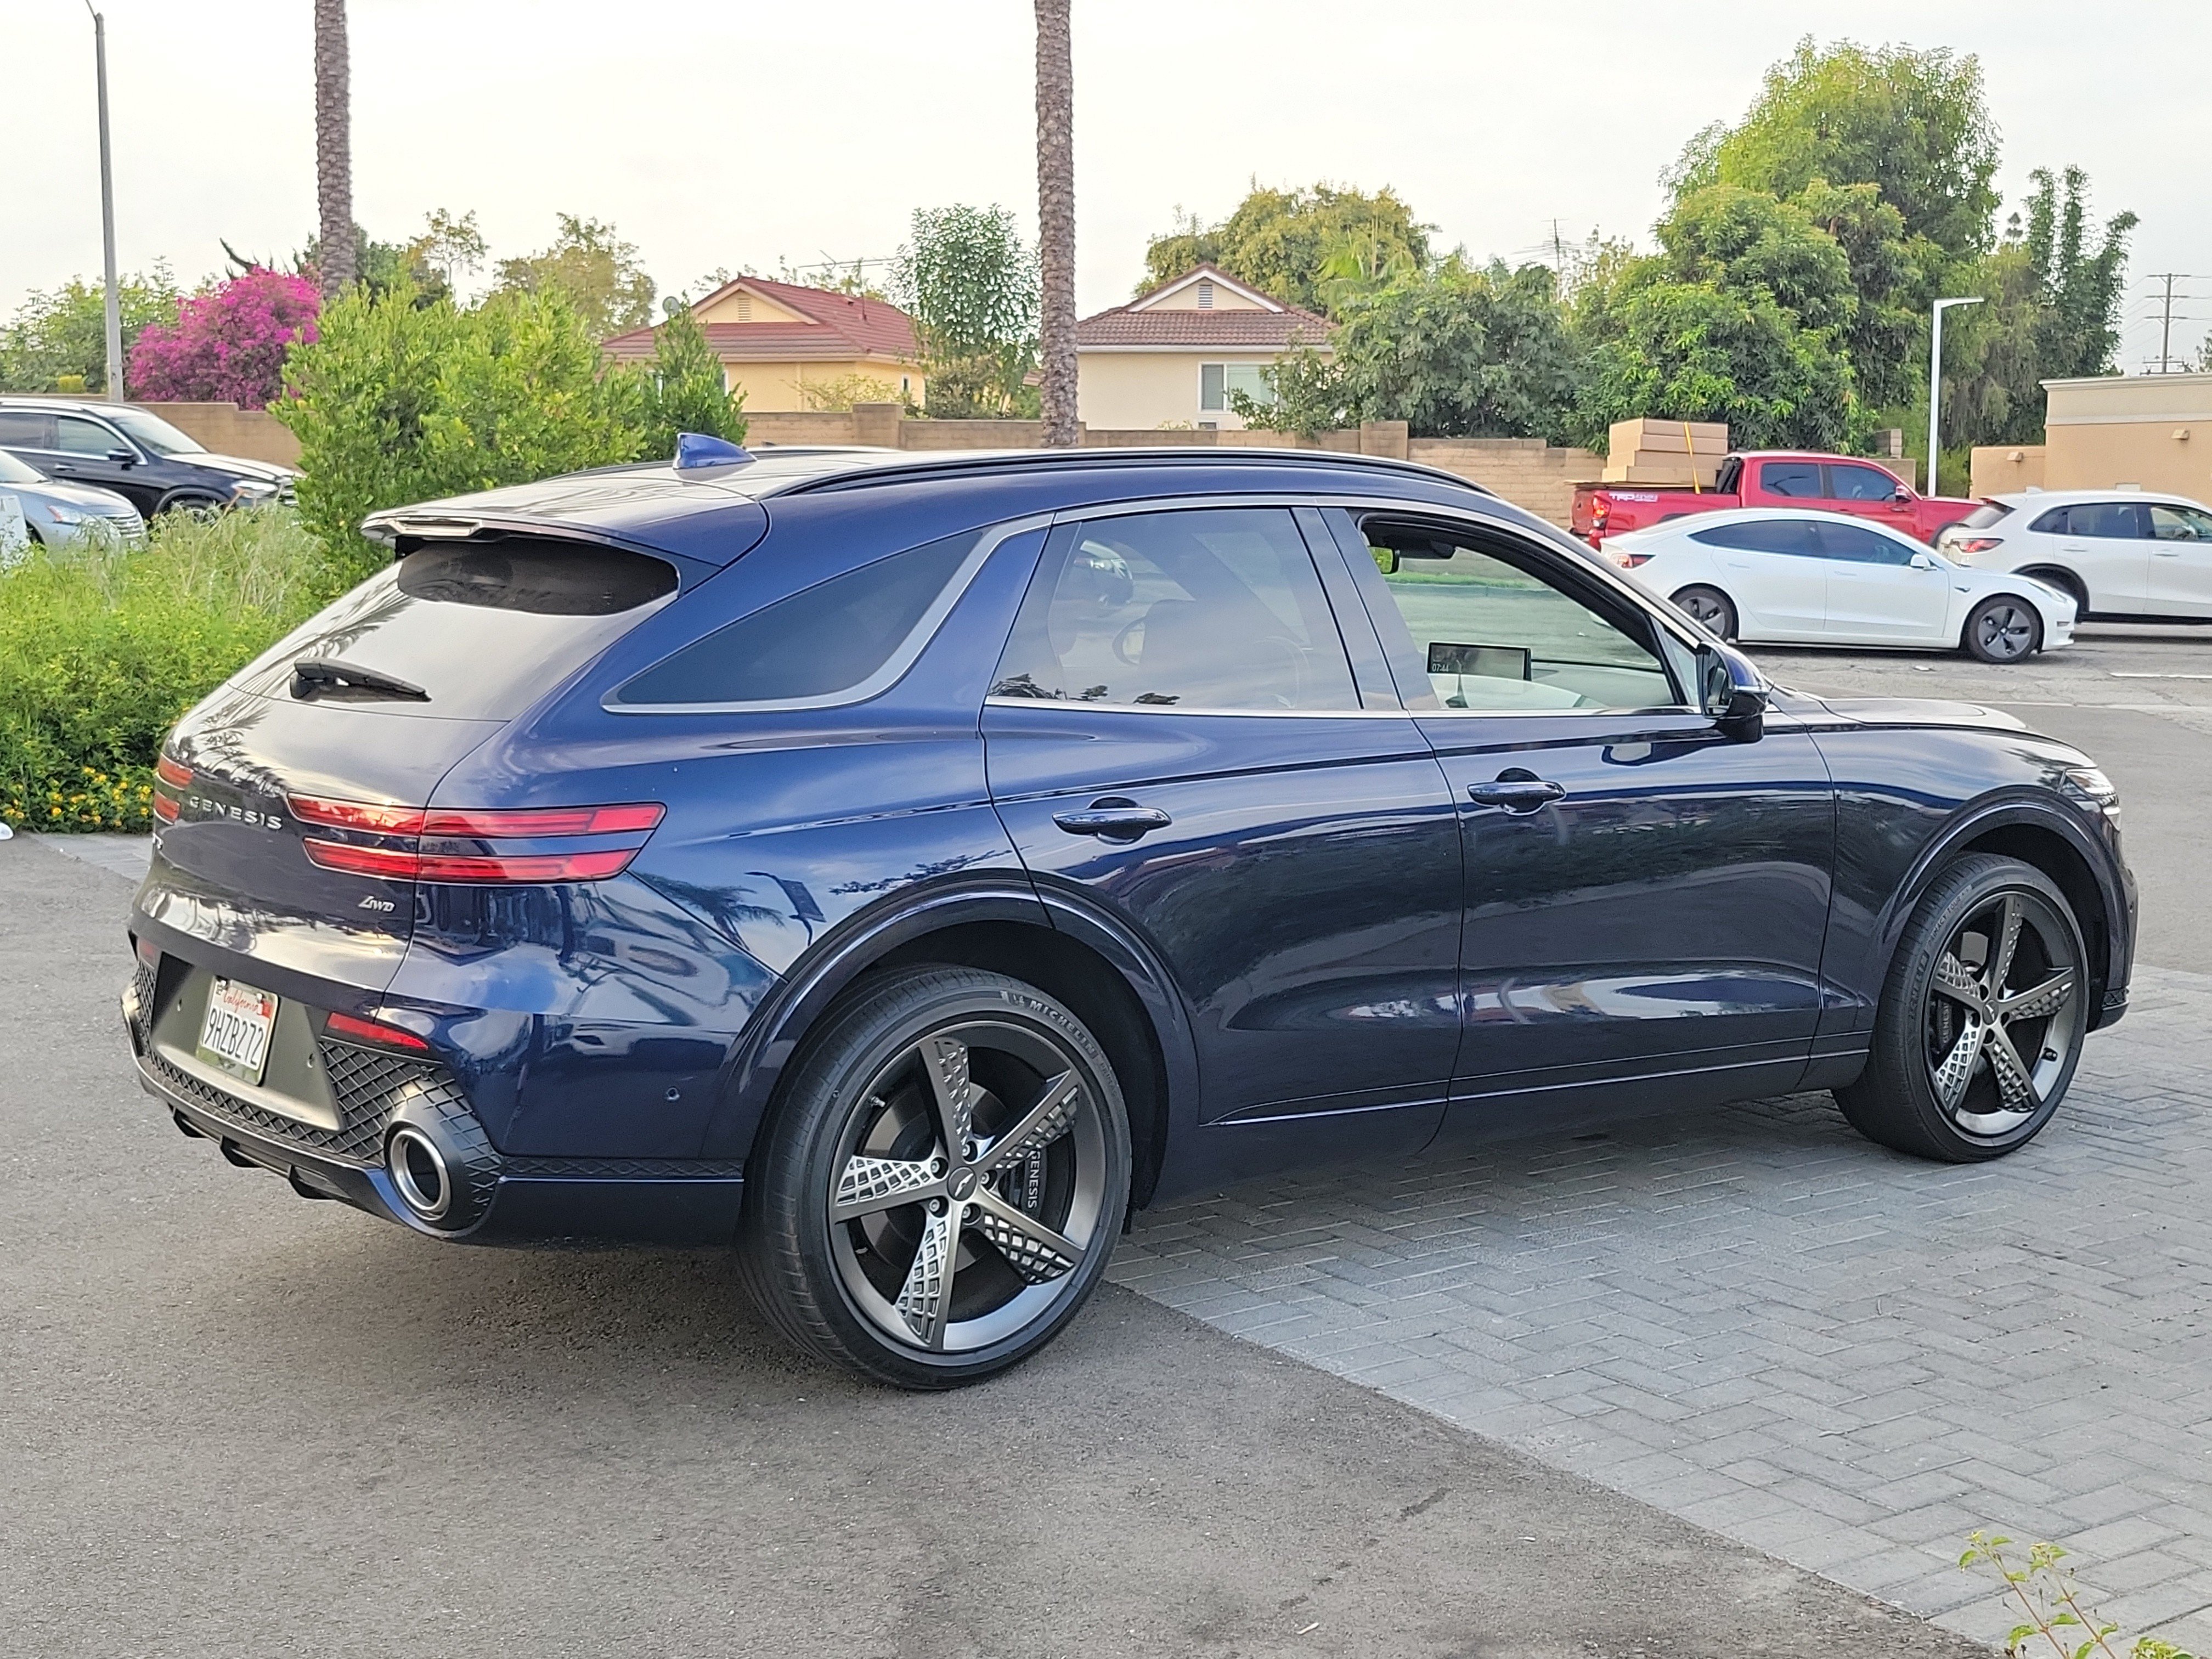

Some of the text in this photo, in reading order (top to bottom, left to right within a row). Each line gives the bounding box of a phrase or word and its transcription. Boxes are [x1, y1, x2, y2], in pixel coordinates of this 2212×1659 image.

[1431, 663, 1449, 673] 07:44
[189, 795, 282, 830] GENESIS
[223, 989, 258, 1013] California
[205, 1008, 263, 1066] 9HZB272
[1029, 1000, 1096, 1055] MICHELIN
[1028, 1150, 1041, 1209] GENESIS
